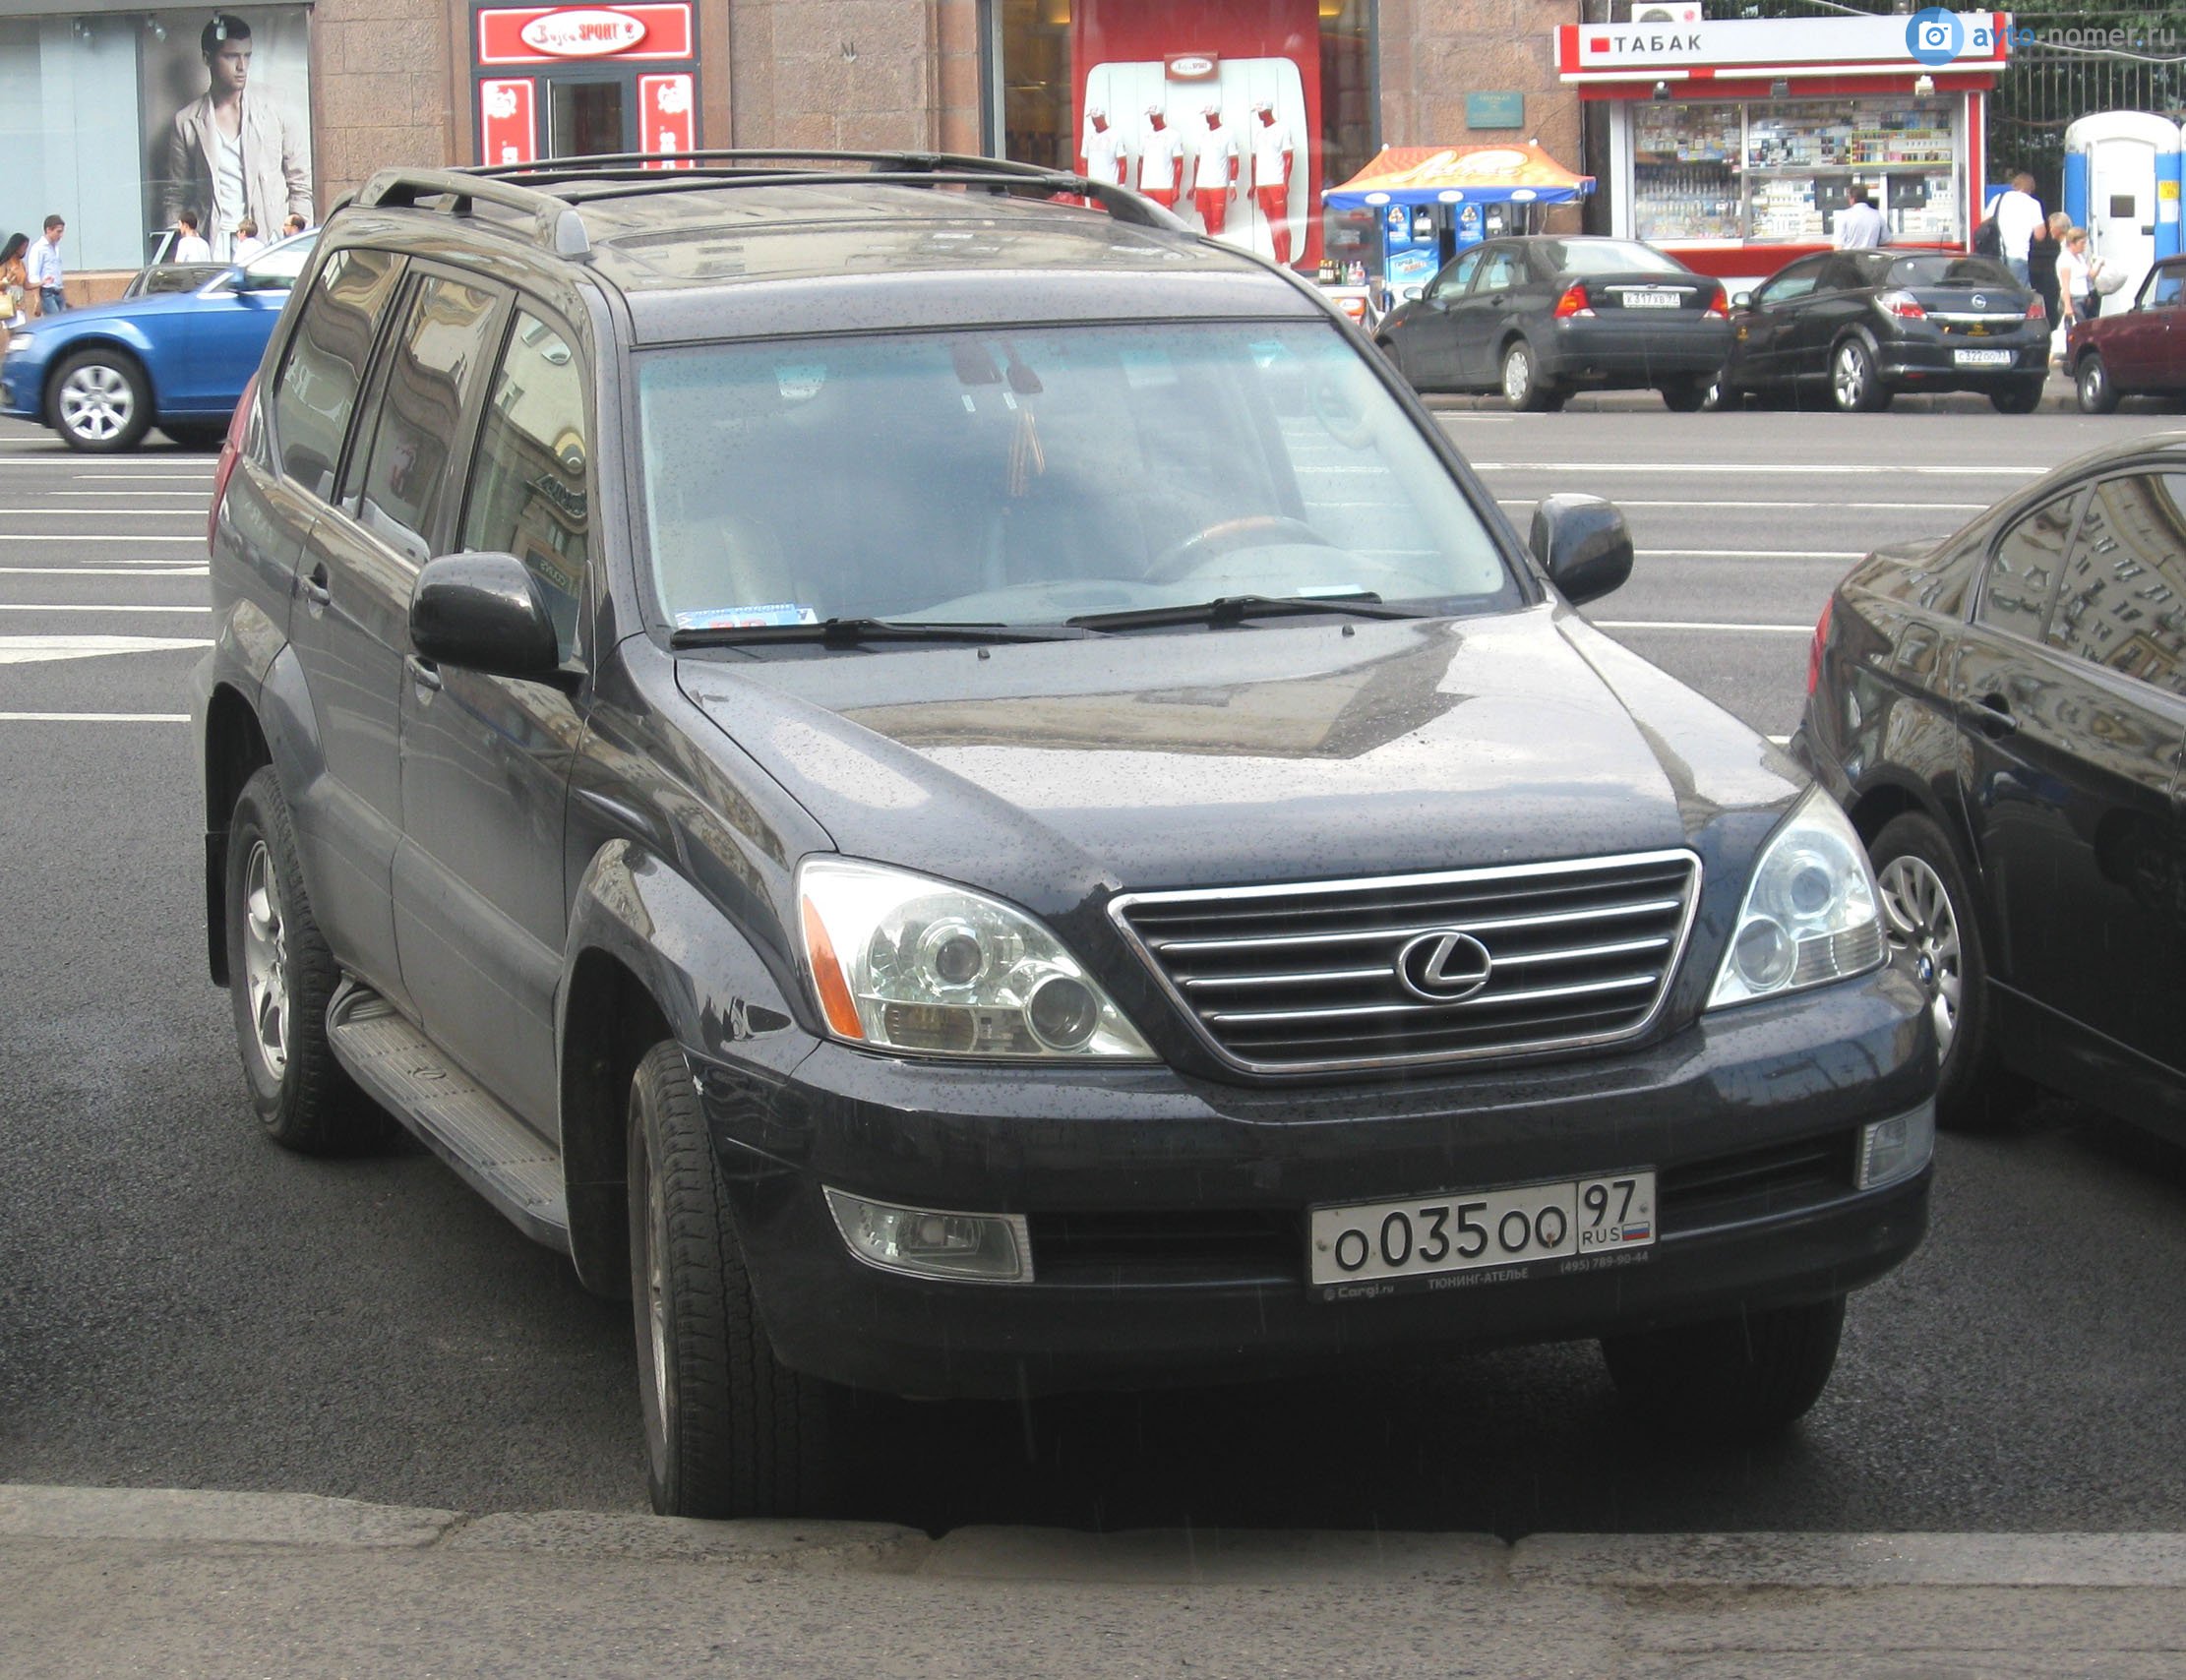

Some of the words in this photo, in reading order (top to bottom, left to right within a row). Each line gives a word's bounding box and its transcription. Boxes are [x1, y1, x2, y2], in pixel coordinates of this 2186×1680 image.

[577, 23, 619, 41] SPORT
[1613, 33, 1702, 53] ТАБАК
[1583, 1179, 1637, 1228] 97
[1582, 1227, 1621, 1246] RUS
[1560, 1259, 1591, 1275] (495)
[1427, 1267, 1529, 1290] ТЮНИНГ-АТЕЛЬЕ
